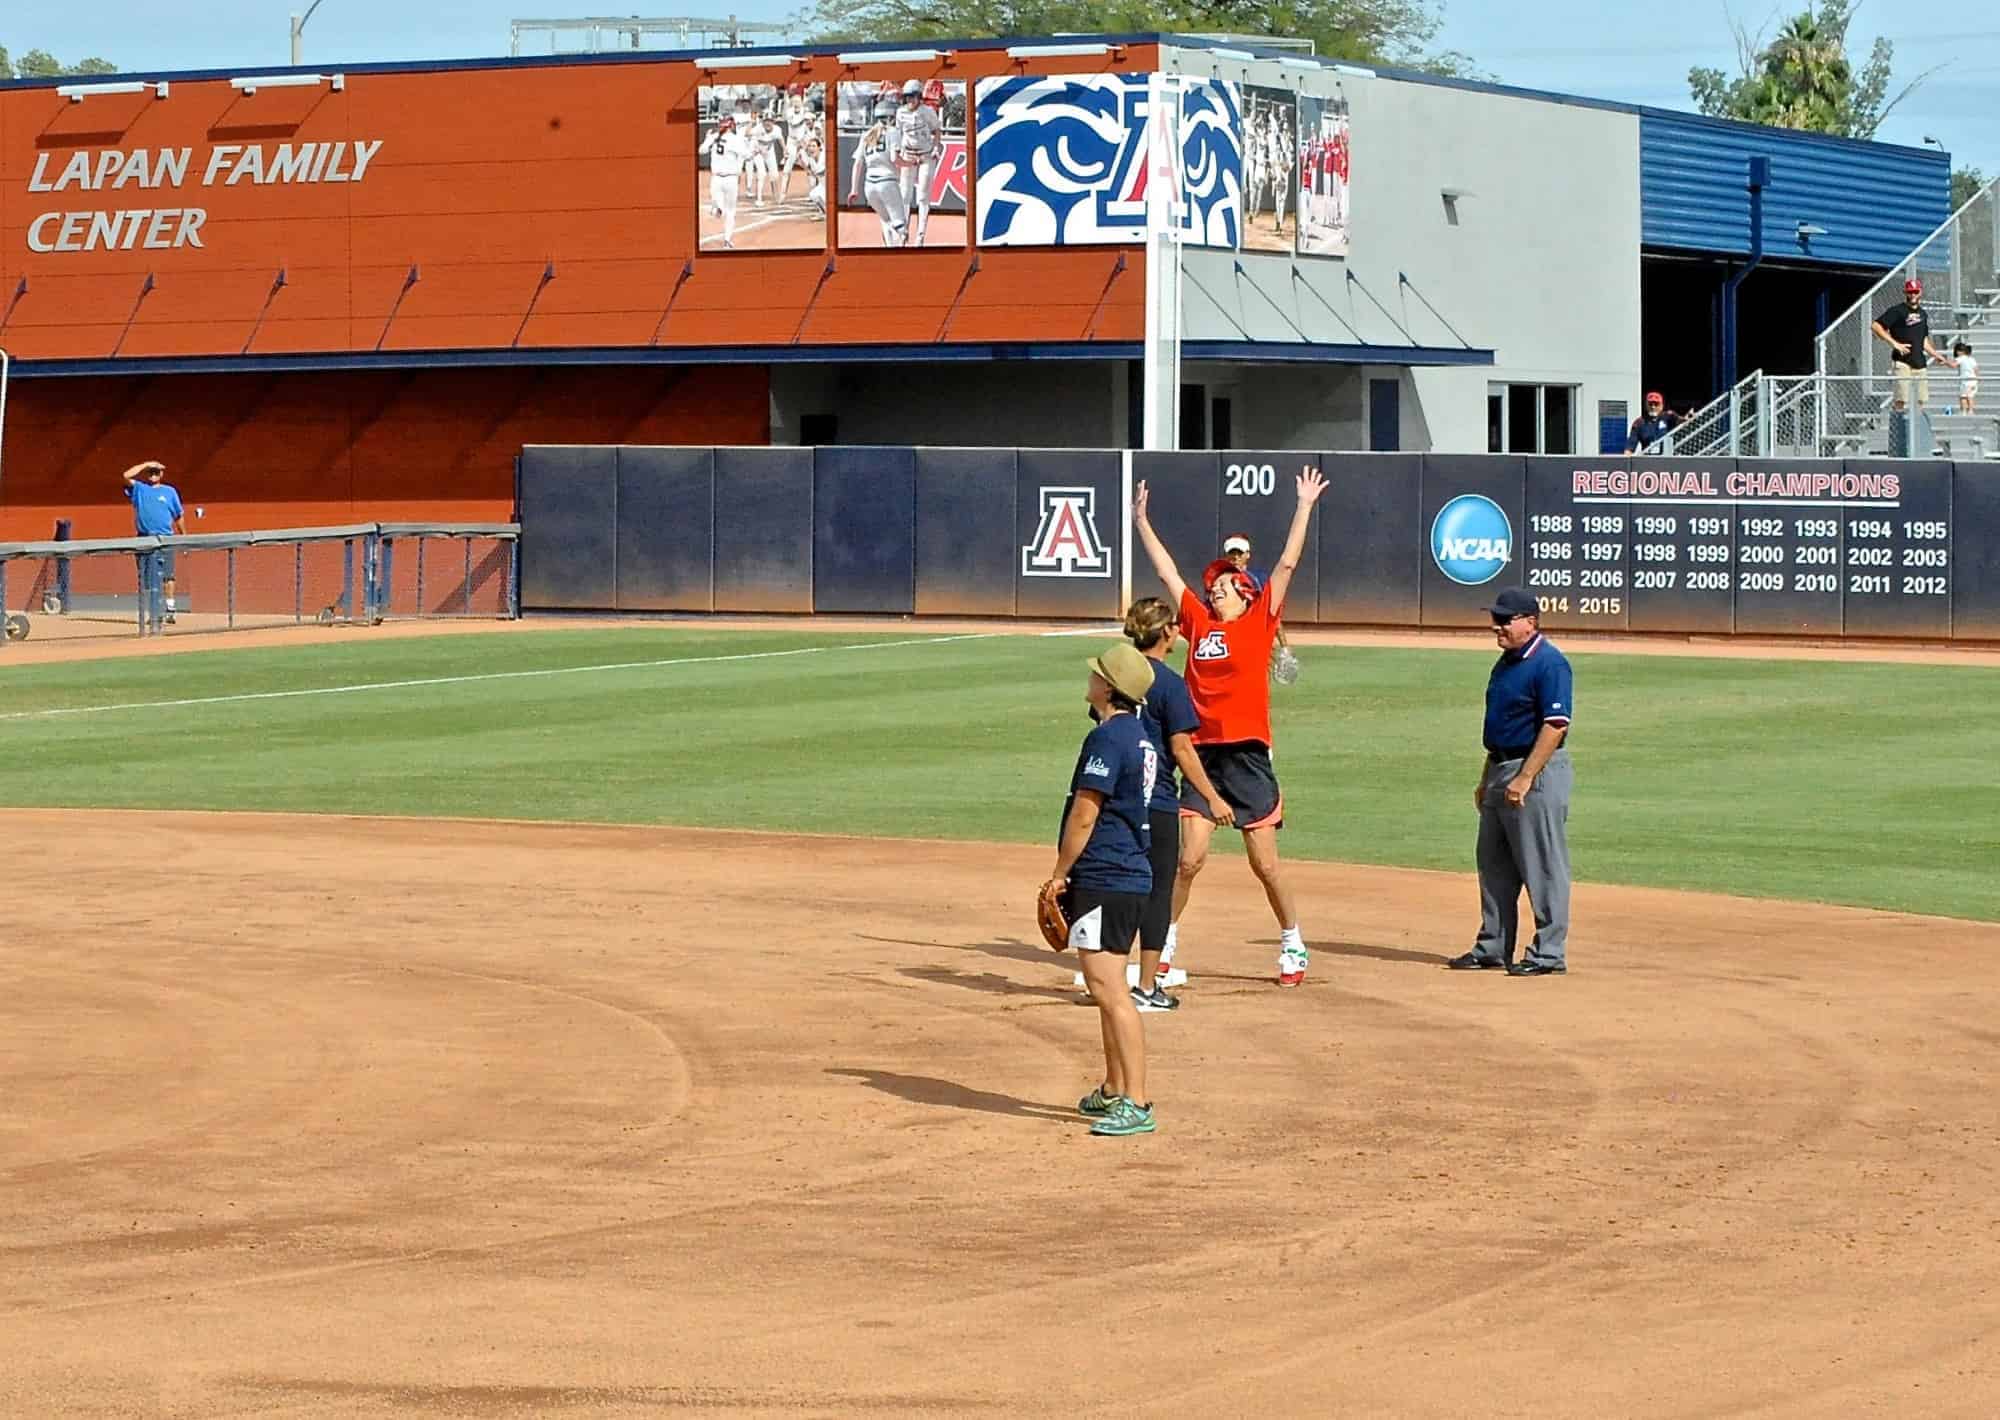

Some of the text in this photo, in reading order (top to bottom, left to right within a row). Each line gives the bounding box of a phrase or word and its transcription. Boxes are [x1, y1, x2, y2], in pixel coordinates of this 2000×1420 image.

[27, 140, 384, 192] LAPAN FAMILY
[26, 208, 207, 253] CENTER
[1225, 464, 1276, 495] 200
[1572, 470, 1900, 498] REGIONAL CHAMPIONS
[1022, 486, 1112, 577] A
[1530, 515, 1947, 539] 1988 1989 1990 1991 1992 1993 1994 1995
[1440, 538, 1509, 562] NCAA
[1530, 541, 1947, 567] 1996 1997 1998 1999 2000 2001 2002 2003
[1529, 568, 1947, 594] 2005 2006 2007 2008 2009 2010 2011 2012
[1535, 596, 1621, 615] 014 2015
